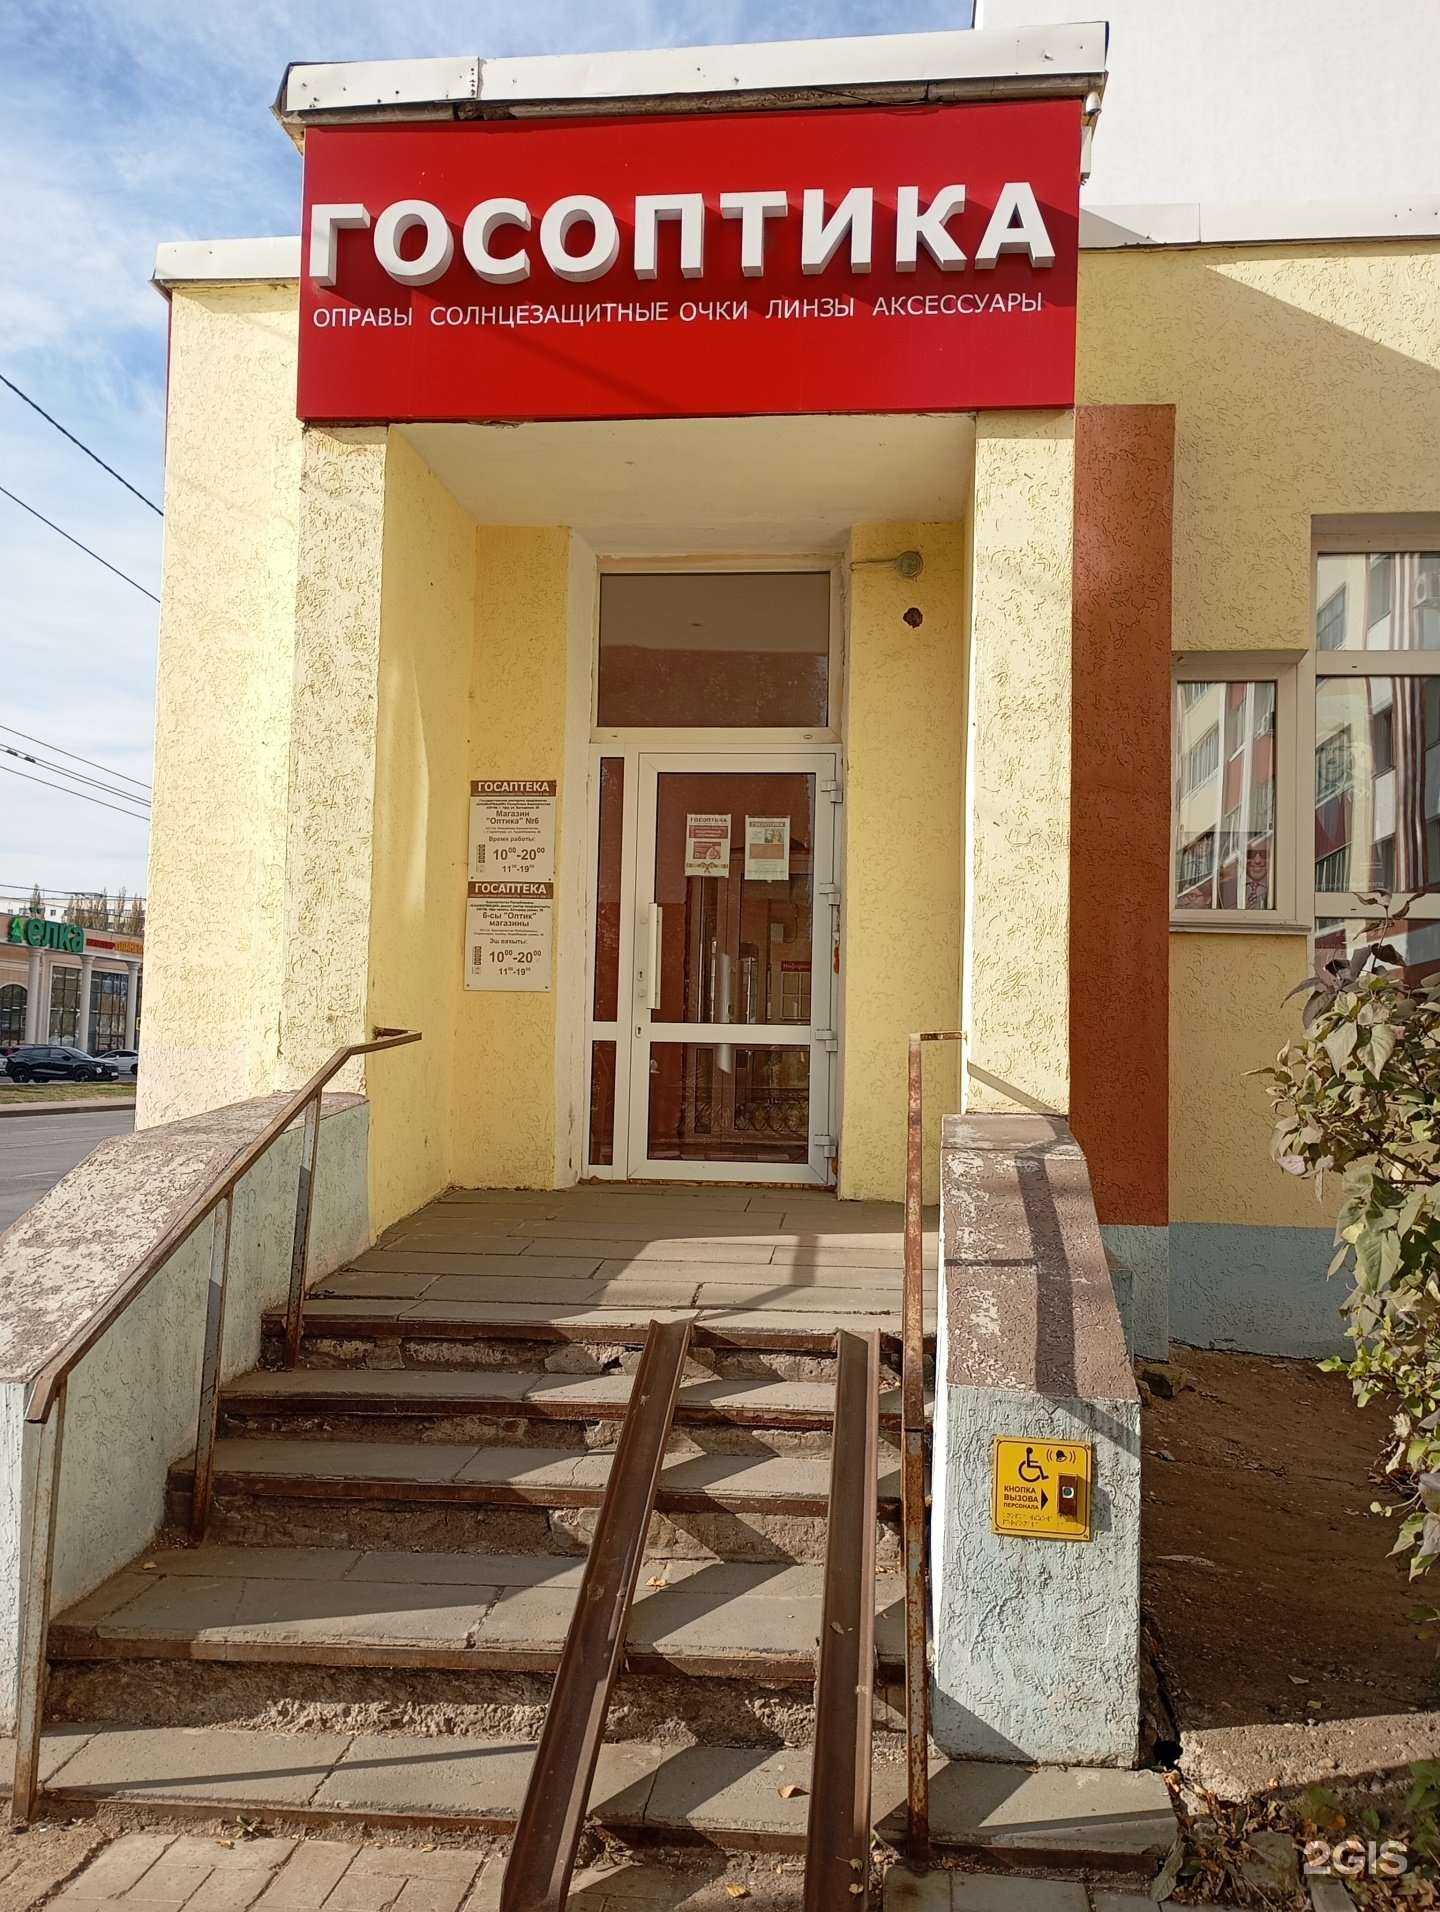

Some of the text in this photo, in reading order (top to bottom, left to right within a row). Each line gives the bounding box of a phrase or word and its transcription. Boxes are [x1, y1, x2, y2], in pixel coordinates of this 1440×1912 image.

[308, 181, 1056, 287] ГОСОПТИКА
[312, 292, 1043, 328] ОПРАВЫ СОЛНЦЕЗАЩИТНЫЕ ОЧКИ ЛИНЗЫ АКСЕССУАРЫ
[478, 781, 550, 792] ГОСАПТЕКА
[495, 810, 530, 818] Магазин
[475, 883, 547, 894] ГОСАПТЕКА
[1004, 1485, 1036, 1493] КНОПКА
[1003, 1494, 1038, 1502] ВЫЗОВА
